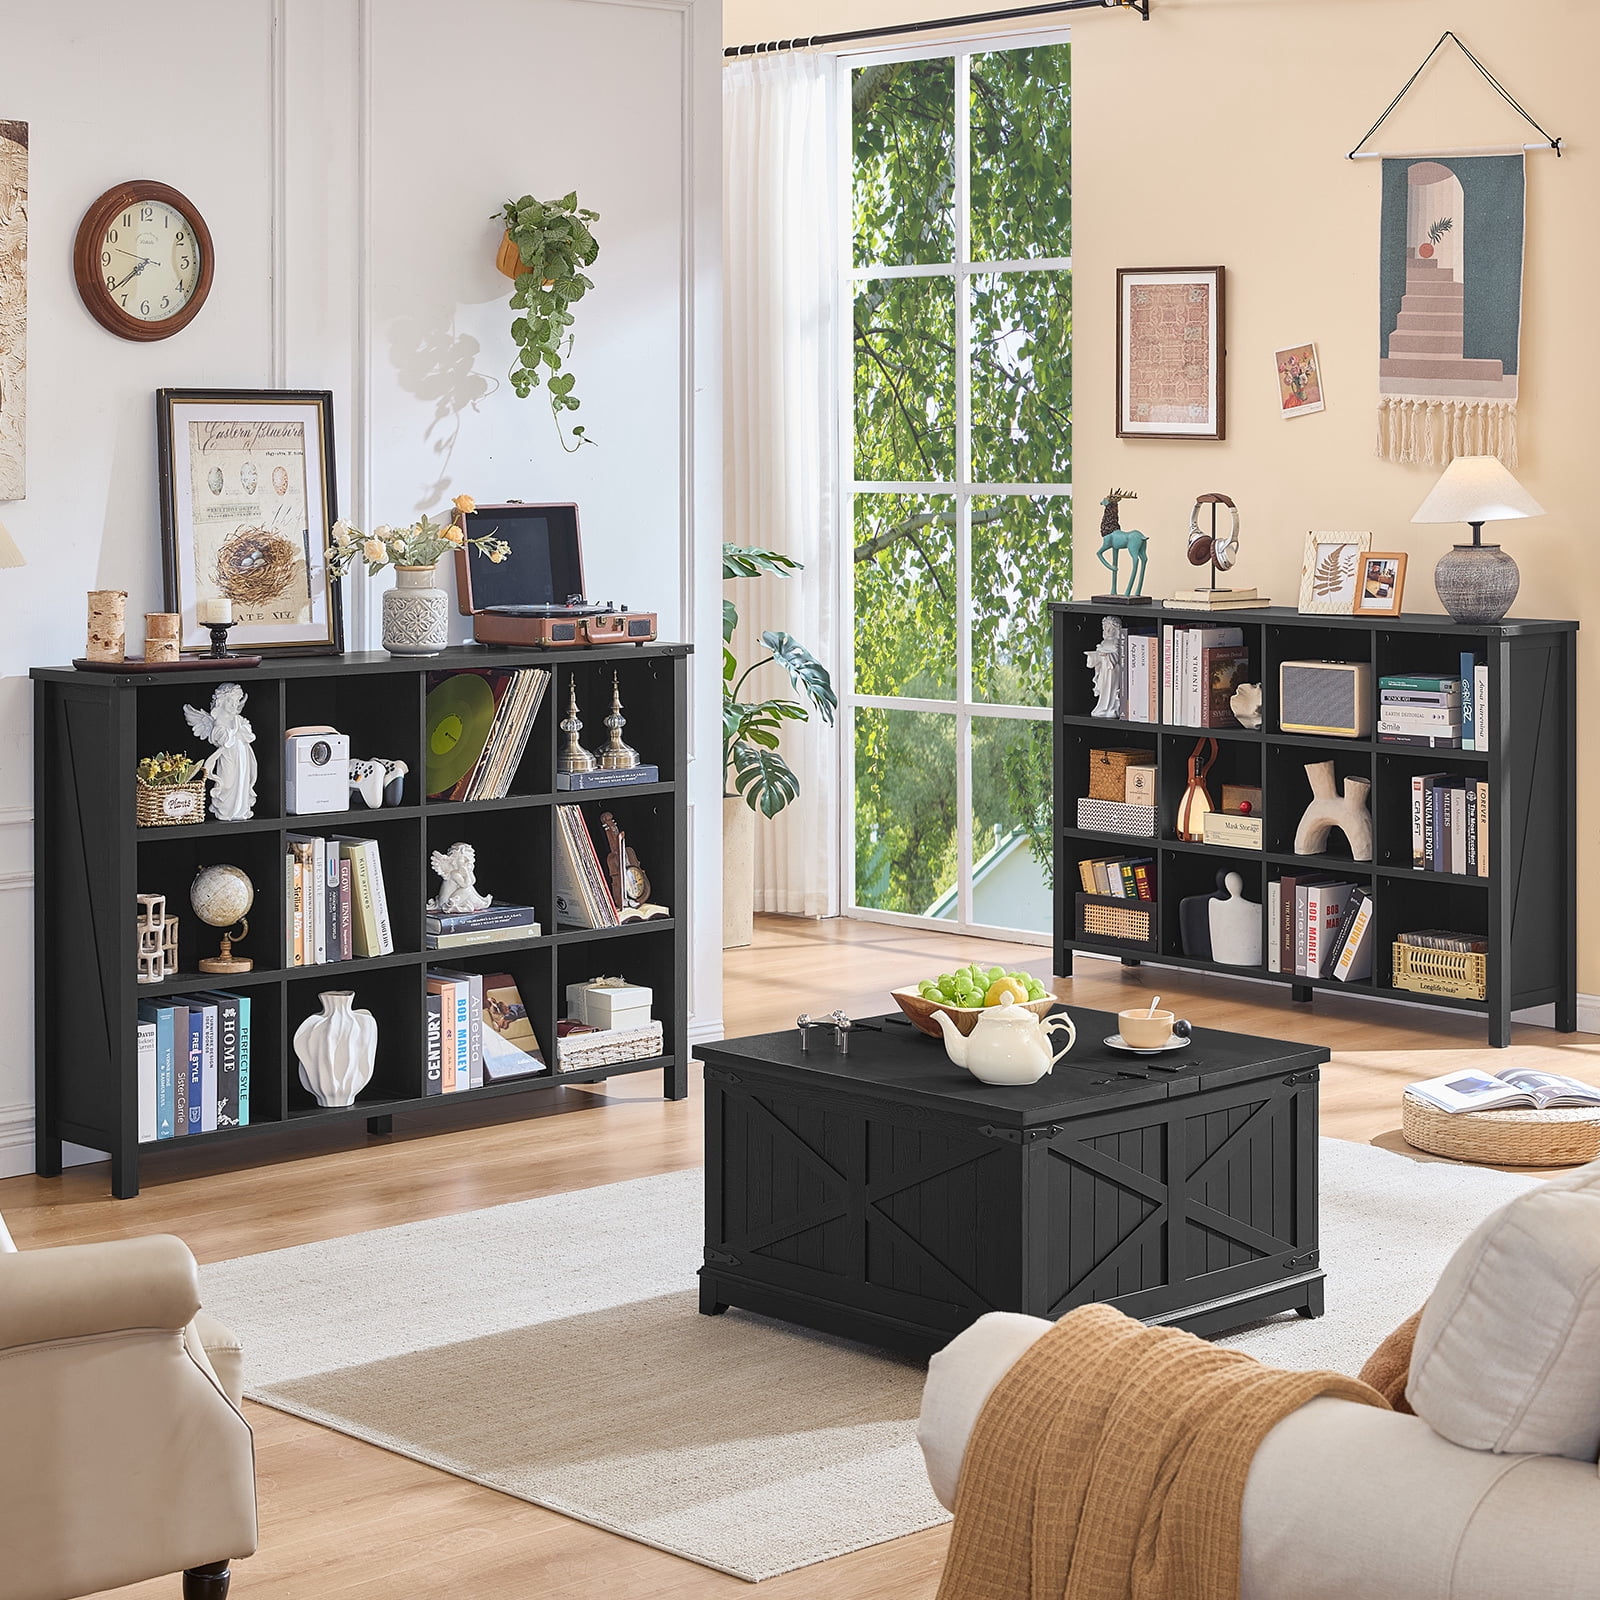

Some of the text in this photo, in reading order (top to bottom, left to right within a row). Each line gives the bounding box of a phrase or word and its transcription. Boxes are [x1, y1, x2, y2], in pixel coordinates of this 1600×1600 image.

[123, 214, 130, 227] 11
[140, 206, 153, 222] 12
[106, 229, 118, 243] 10
[176, 232, 184, 246] 2
[102, 252, 111, 266] 9
[180, 256, 189, 270] 3
[106, 276, 116, 291] 8
[175, 279, 184, 292] 4
[121, 294, 128, 307] 7
[140, 300, 150, 315] 6
[160, 296, 169, 308] 5
[1381, 722, 1400, 731] Smile
[1425, 789, 1433, 824] ANNUAL
[1326, 905, 1339, 915] BOB
[1309, 902, 1317, 963] BOB MARLEY
[1341, 948, 1353, 967] BOB
[1349, 911, 1368, 946] MARLEY
[458, 999, 467, 1072] BOB MARLEY
[224, 1020, 235, 1072] HOME
[428, 1012, 440, 1080] CENTURY
[177, 1072, 186, 1123] Sister Carrie
